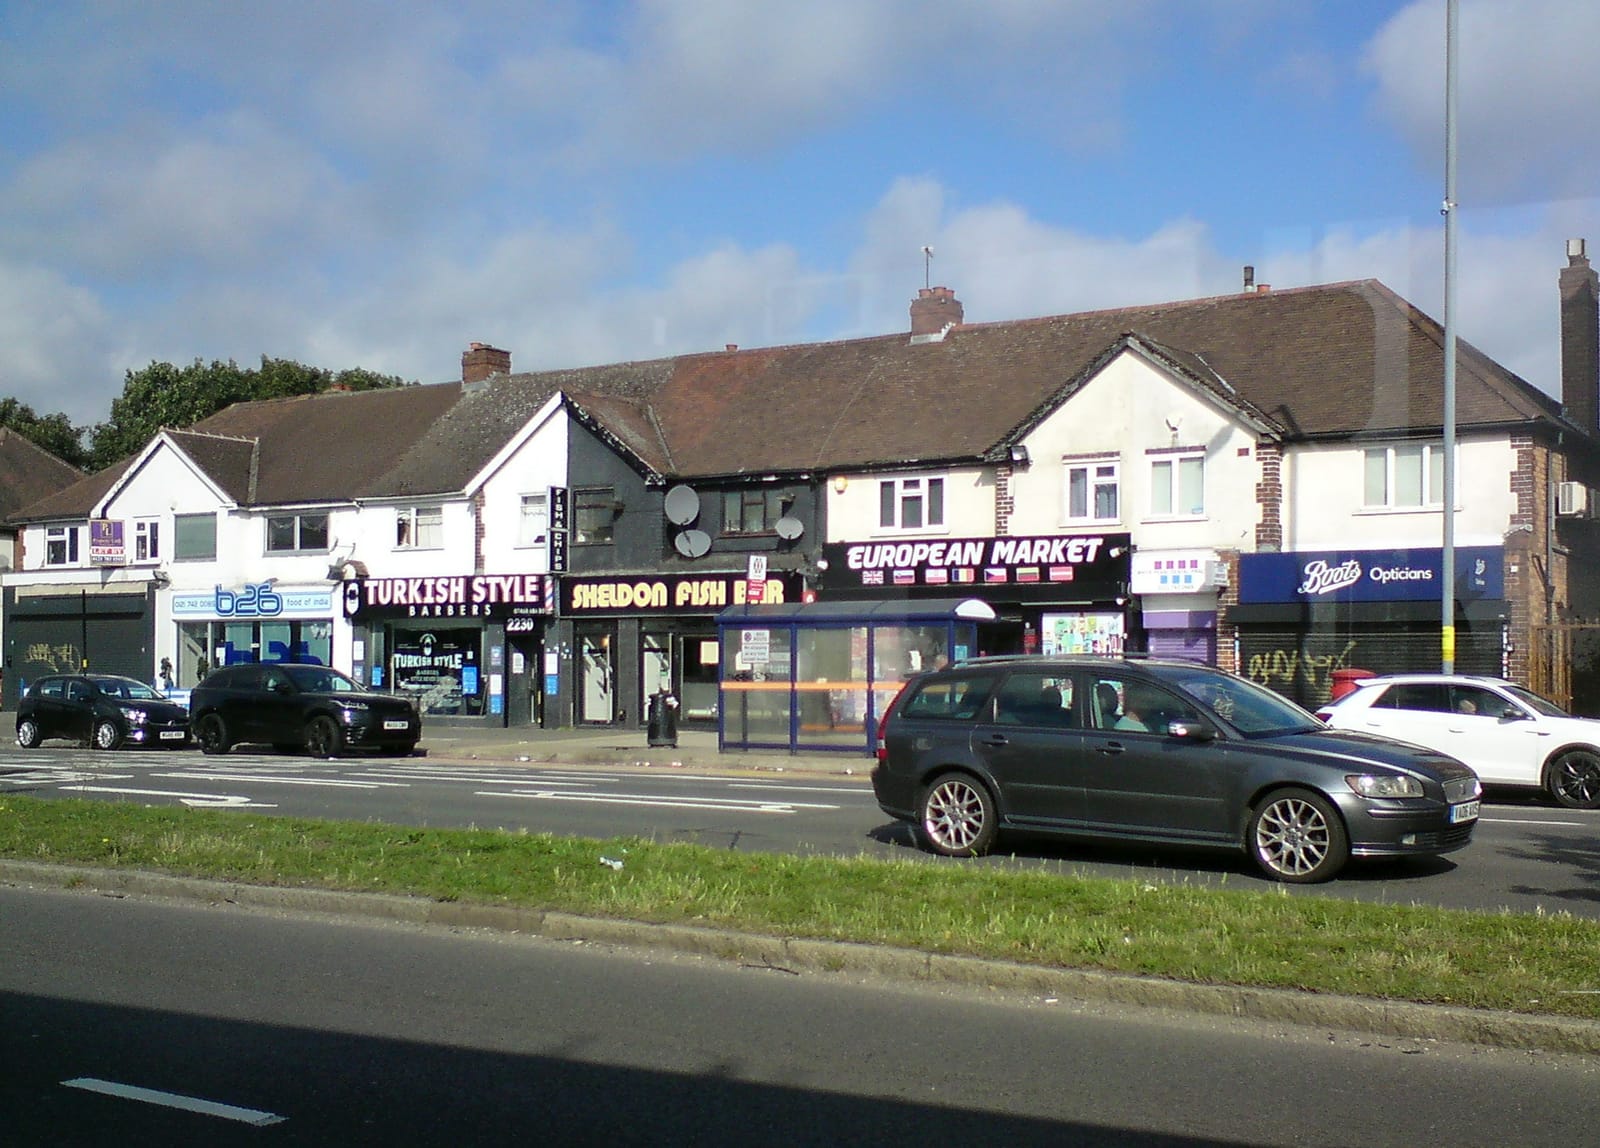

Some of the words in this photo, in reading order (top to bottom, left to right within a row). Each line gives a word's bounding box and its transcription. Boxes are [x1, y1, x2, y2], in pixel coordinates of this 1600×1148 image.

[555, 489, 563, 519] FISH
[554, 533, 563, 570] CHIPS
[847, 542, 984, 570] EUROPEAN
[991, 538, 1104, 565] MARKET
[364, 577, 466, 606] TURKISH
[472, 575, 539, 604] STYLE
[1297, 559, 1362, 595] Boots
[1369, 567, 1433, 584] Opticians
[215, 583, 283, 616] b26
[287, 597, 302, 607] food
[304, 597, 311, 606] of
[572, 582, 668, 609] SHELDON
[675, 580, 727, 606] FISH
[409, 604, 492, 617] BARBERS
[506, 617, 534, 631] 2230
[394, 653, 432, 669] TURKISH
[434, 653, 463, 669] STYLE
